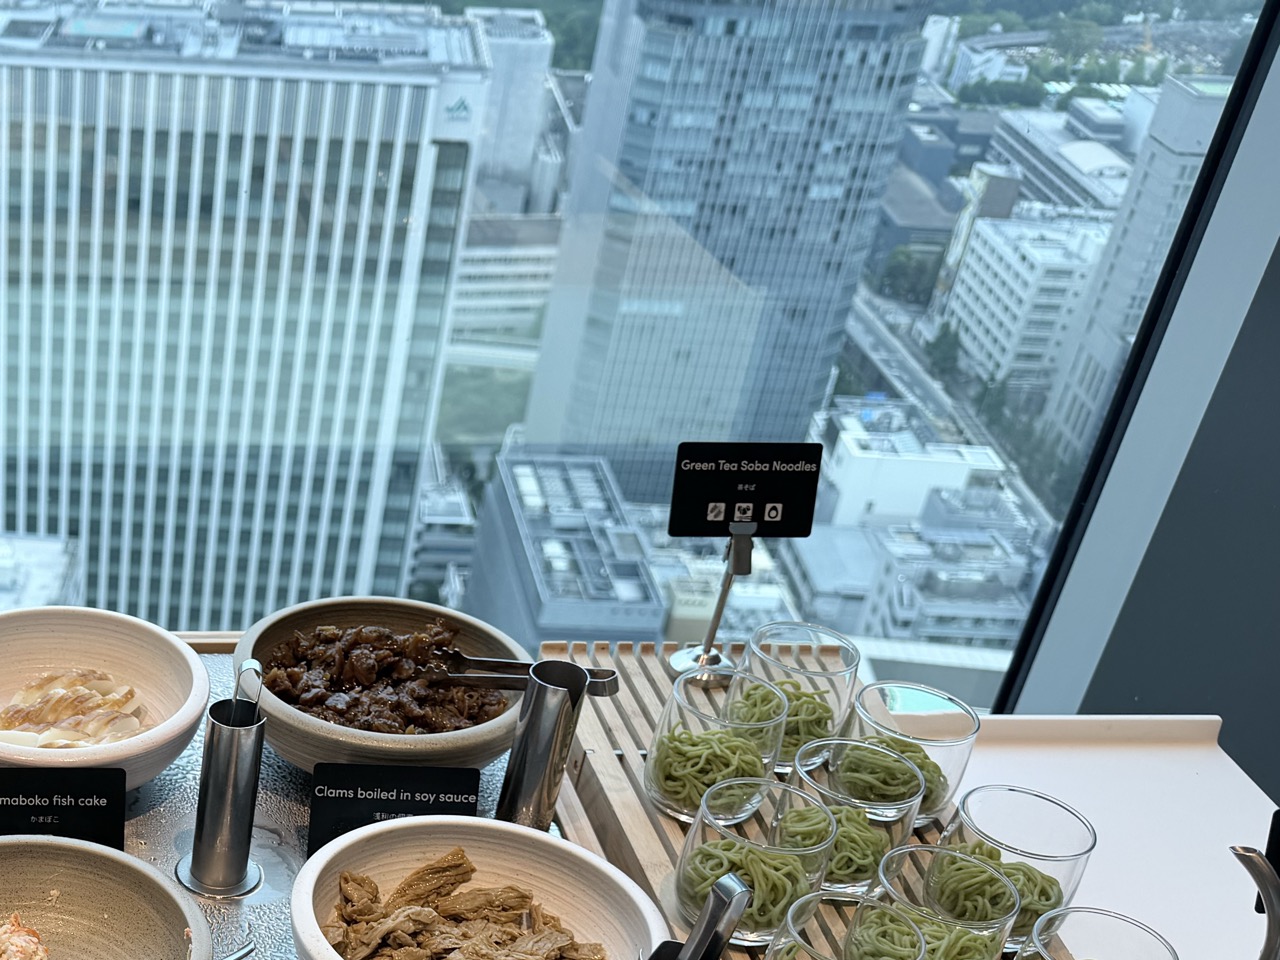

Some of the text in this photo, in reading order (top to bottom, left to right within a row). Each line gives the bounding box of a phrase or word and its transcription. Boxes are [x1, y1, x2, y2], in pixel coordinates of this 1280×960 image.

[681, 459, 817, 471] Green Tea Soba Noodles
[53, 795, 74, 806] fish
[78, 795, 107, 806] cake
[315, 786, 476, 804] Clams boiled in soy sauce
